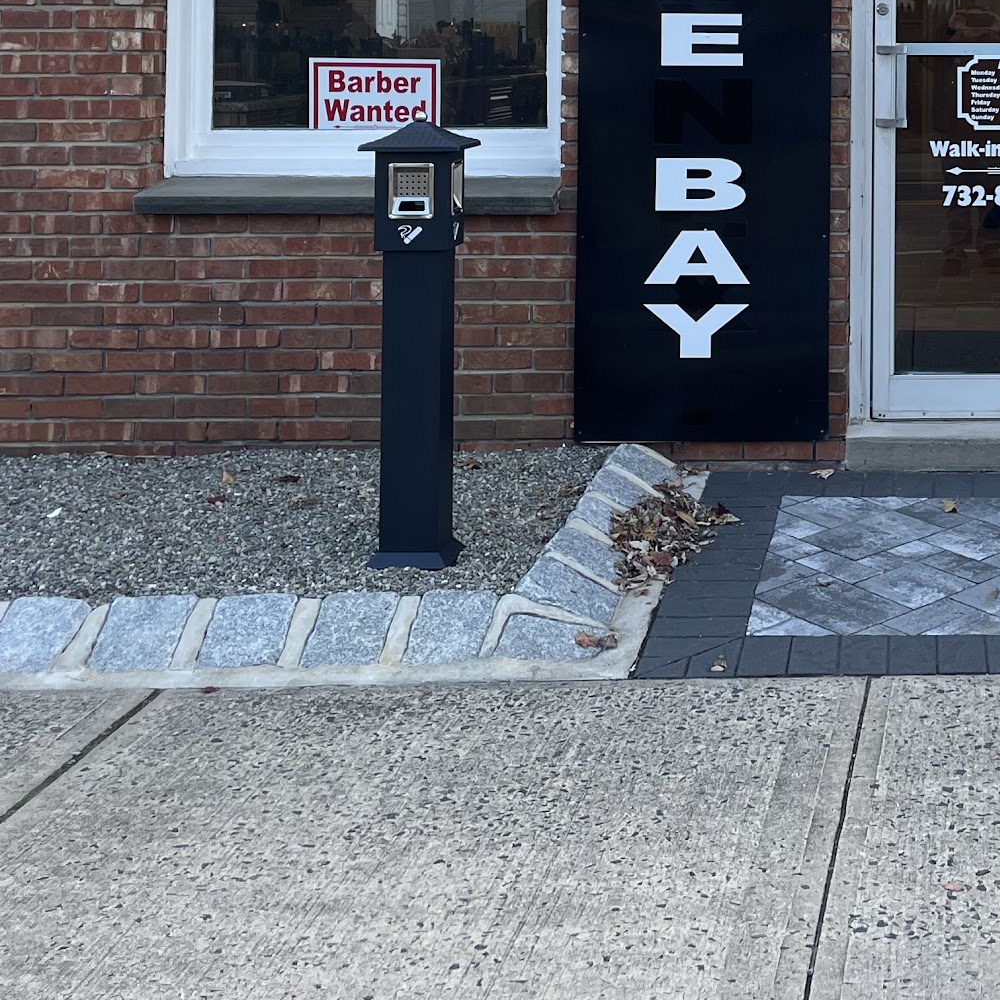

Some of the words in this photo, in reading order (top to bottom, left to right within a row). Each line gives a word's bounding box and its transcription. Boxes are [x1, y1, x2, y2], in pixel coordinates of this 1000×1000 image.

[328, 70, 421, 94] Barber
[324, 99, 427, 123] Wanted
[643, 157, 750, 359] BAY
